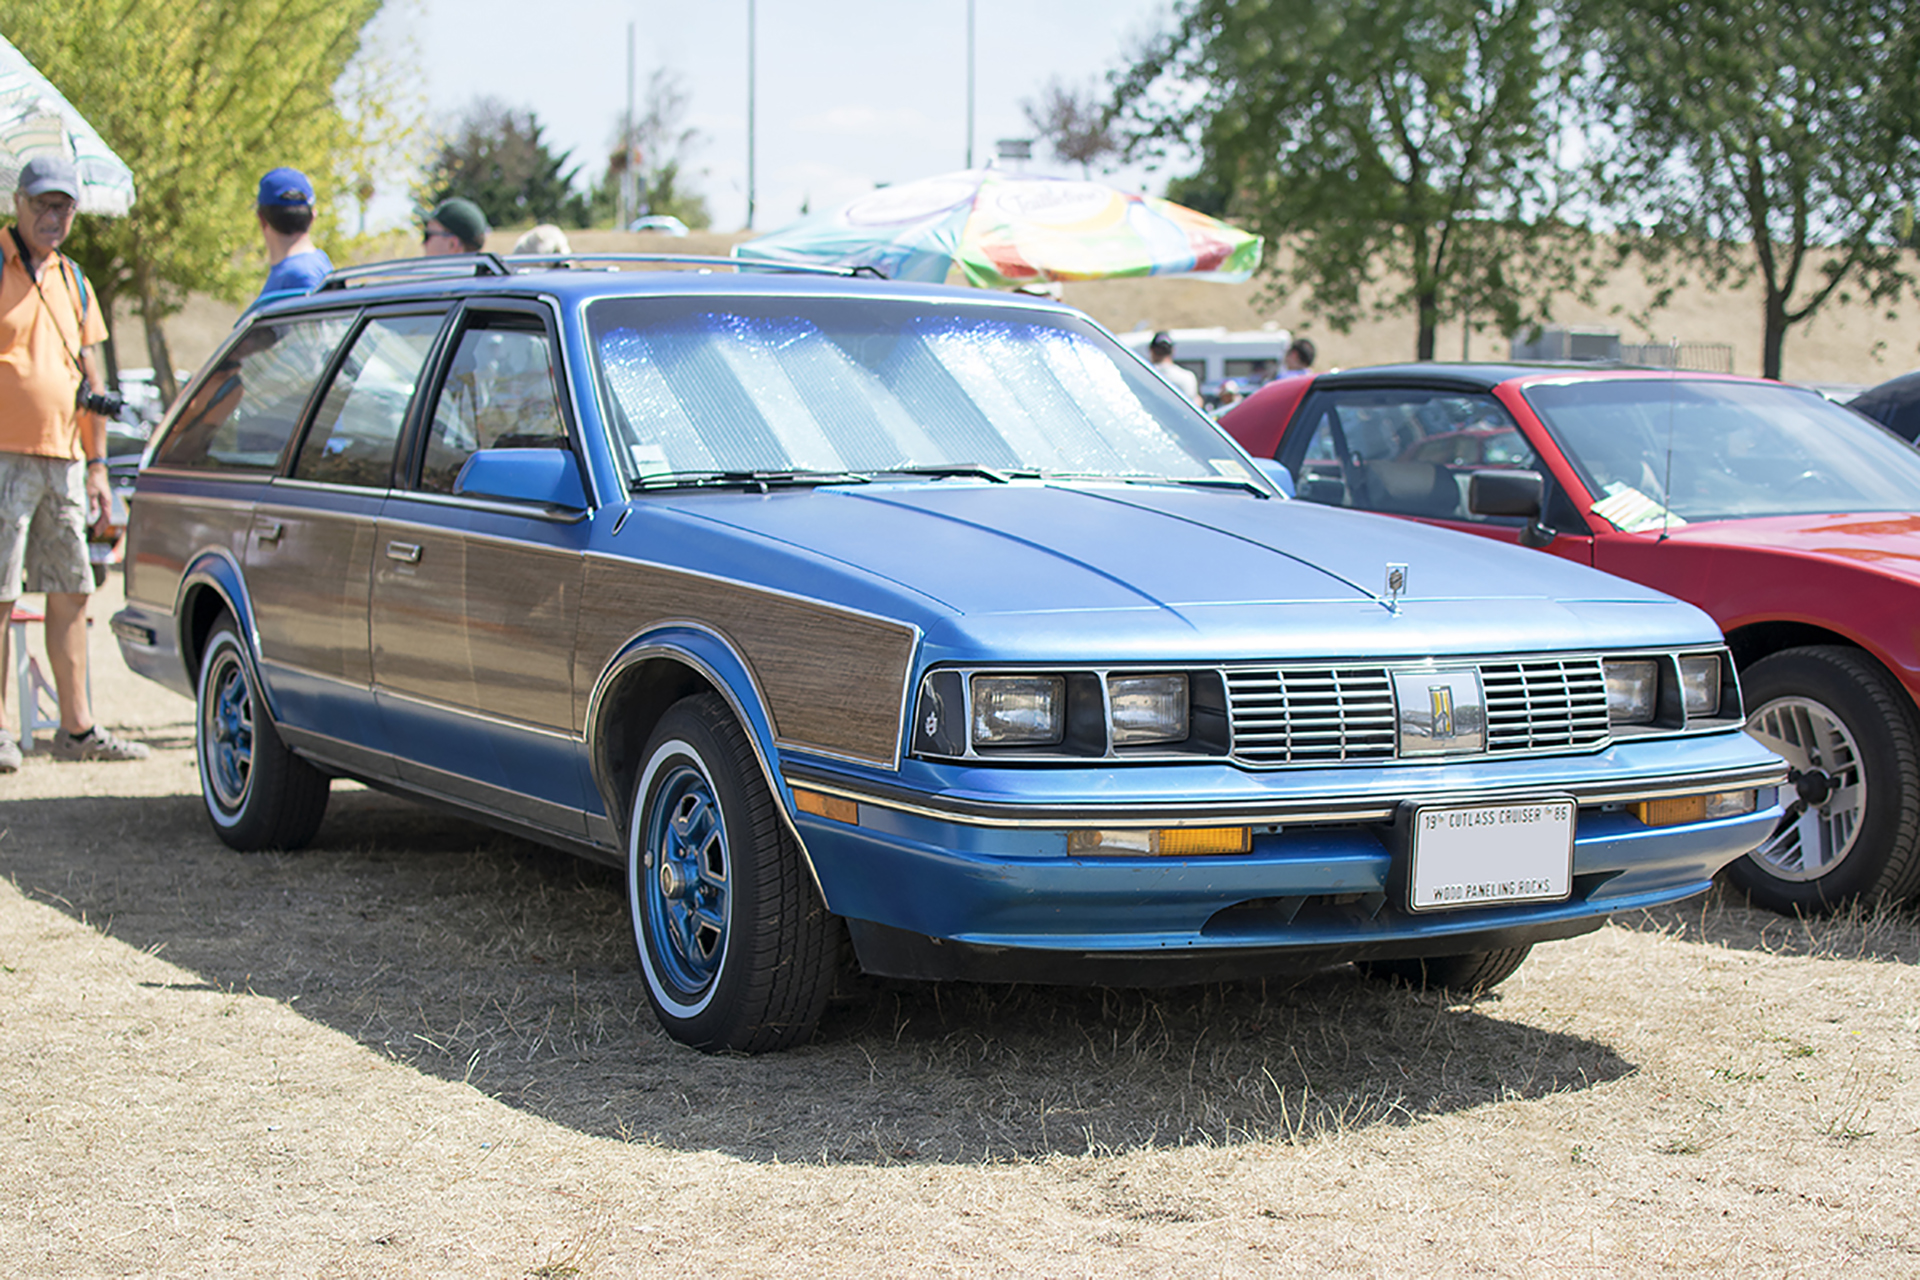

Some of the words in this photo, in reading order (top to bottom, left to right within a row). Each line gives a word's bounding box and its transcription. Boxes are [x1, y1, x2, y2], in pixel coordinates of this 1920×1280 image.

[1425, 815, 1437, 829] 19
[1449, 811, 1495, 828] CUTLASS
[1499, 808, 1541, 824] CRUISER
[1433, 885, 1463, 900] WOOD
[1465, 881, 1516, 898] PANELING
[1518, 878, 1550, 894] ROCKS
